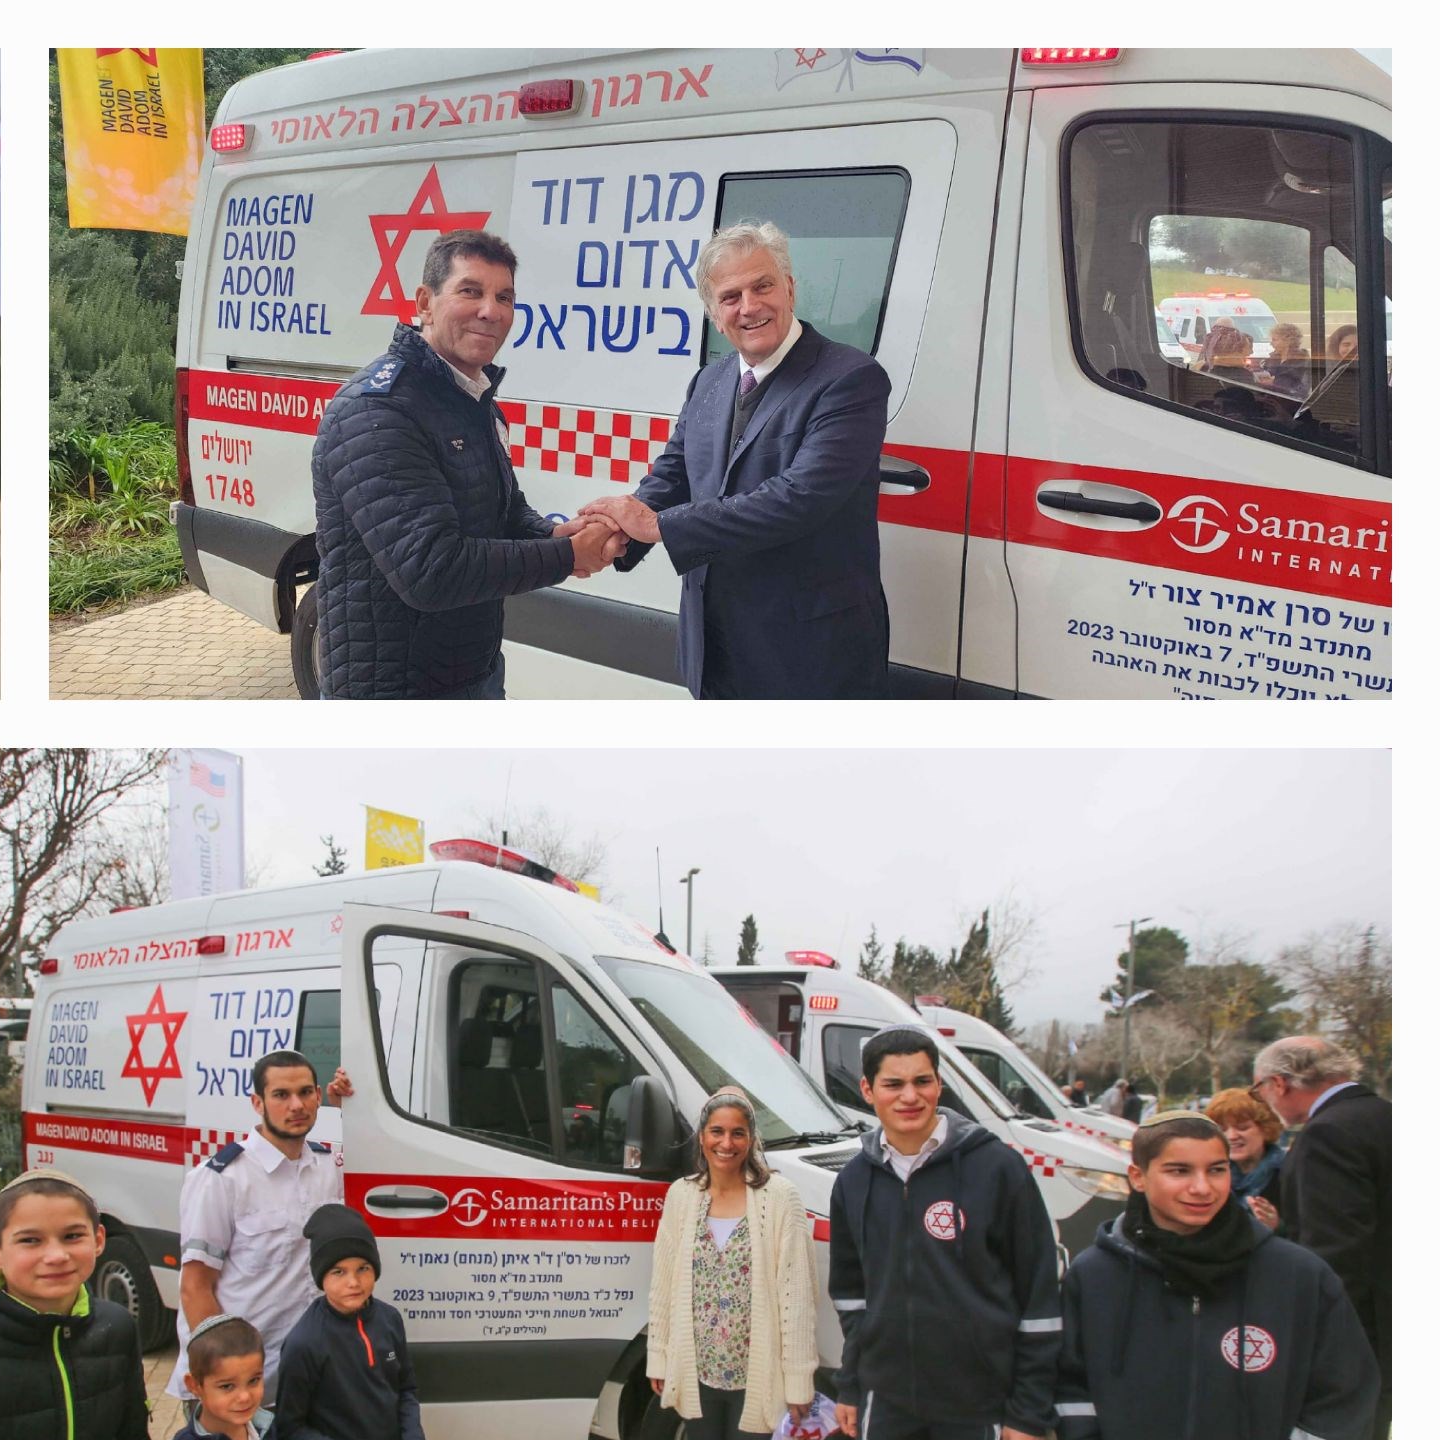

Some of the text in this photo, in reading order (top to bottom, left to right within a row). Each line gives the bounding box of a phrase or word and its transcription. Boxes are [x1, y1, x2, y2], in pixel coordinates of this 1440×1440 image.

[101, 79, 118, 132] MAGEN
[120, 89, 135, 134] DAVID
[134, 90, 151, 136] ADOM
[149, 72, 168, 139] IN ISRAEL
[271, 64, 714, 145] ארגון ההצלה הלאומי
[226, 193, 314, 226] MAGEN
[531, 171, 706, 233] מגן דוד
[223, 231, 296, 261] DAVID
[576, 239, 701, 289] אדום
[220, 266, 294, 296] ADOM
[217, 300, 331, 335] IN ISRAEL
[513, 303, 691, 356] בישראל
[207, 385, 257, 412] MAGEN
[262, 392, 308, 418] DAVID
[201, 430, 252, 465] ירושלים
[206, 474, 256, 507] 1748
[1237, 503, 1392, 553] Samari
[1129, 579, 1157, 599] ז"ל
[1162, 584, 1203, 606] צור
[1210, 591, 1277, 618] אמיר
[1286, 603, 1331, 627] סרן
[1067, 619, 1114, 641] 2023
[1339, 611, 1375, 633] של
[1119, 631, 1212, 660] באוקטובר
[1184, 616, 1372, 661] מתנדב מד"א מסור
[1092, 650, 1157, 674] האהבה
[1162, 663, 1192, 681] את
[1197, 671, 1259, 693] לכבות
[73, 928, 294, 971] ארגון ההצלה הלאומי
[51, 1001, 99, 1022] MAGEN
[210, 988, 294, 1024] מגן דוד
[49, 1024, 88, 1044] DAVID
[230, 1028, 291, 1058] אדום
[47, 1047, 87, 1065] ADOM
[45, 1069, 106, 1091] IN ISRAEL
[36, 1123, 168, 1152] MAGEN DAVID ADOM IN ISRAEL
[618, 1191, 664, 1211] Purs
[492, 1218, 614, 1228] INTERNATIONAL
[419, 1252, 449, 1267] נאמן
[453, 1251, 498, 1267] (מנחם)
[502, 1253, 529, 1268] איתן
[604, 1254, 630, 1265] לזכרו
[393, 1289, 634, 1303] נפל בתשרי באוקטובר 2023
